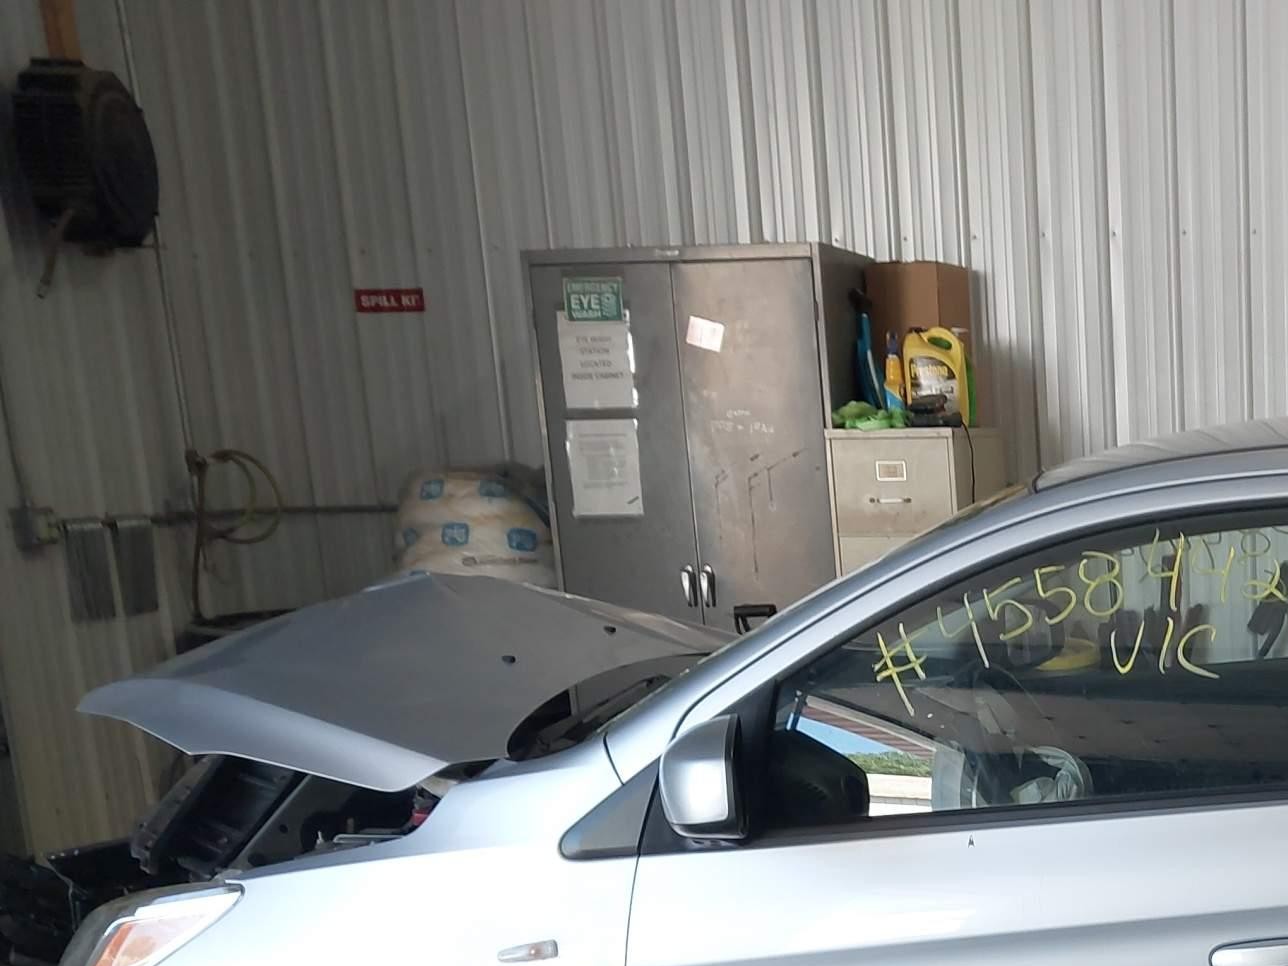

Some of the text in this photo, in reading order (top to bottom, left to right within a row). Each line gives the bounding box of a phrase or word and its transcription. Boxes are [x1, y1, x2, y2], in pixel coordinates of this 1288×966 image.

[360, 295, 399, 308] SPILL
[570, 294, 601, 310] EYE
[571, 309, 602, 319] WASH
[1110, 616, 1221, 679] VIC
